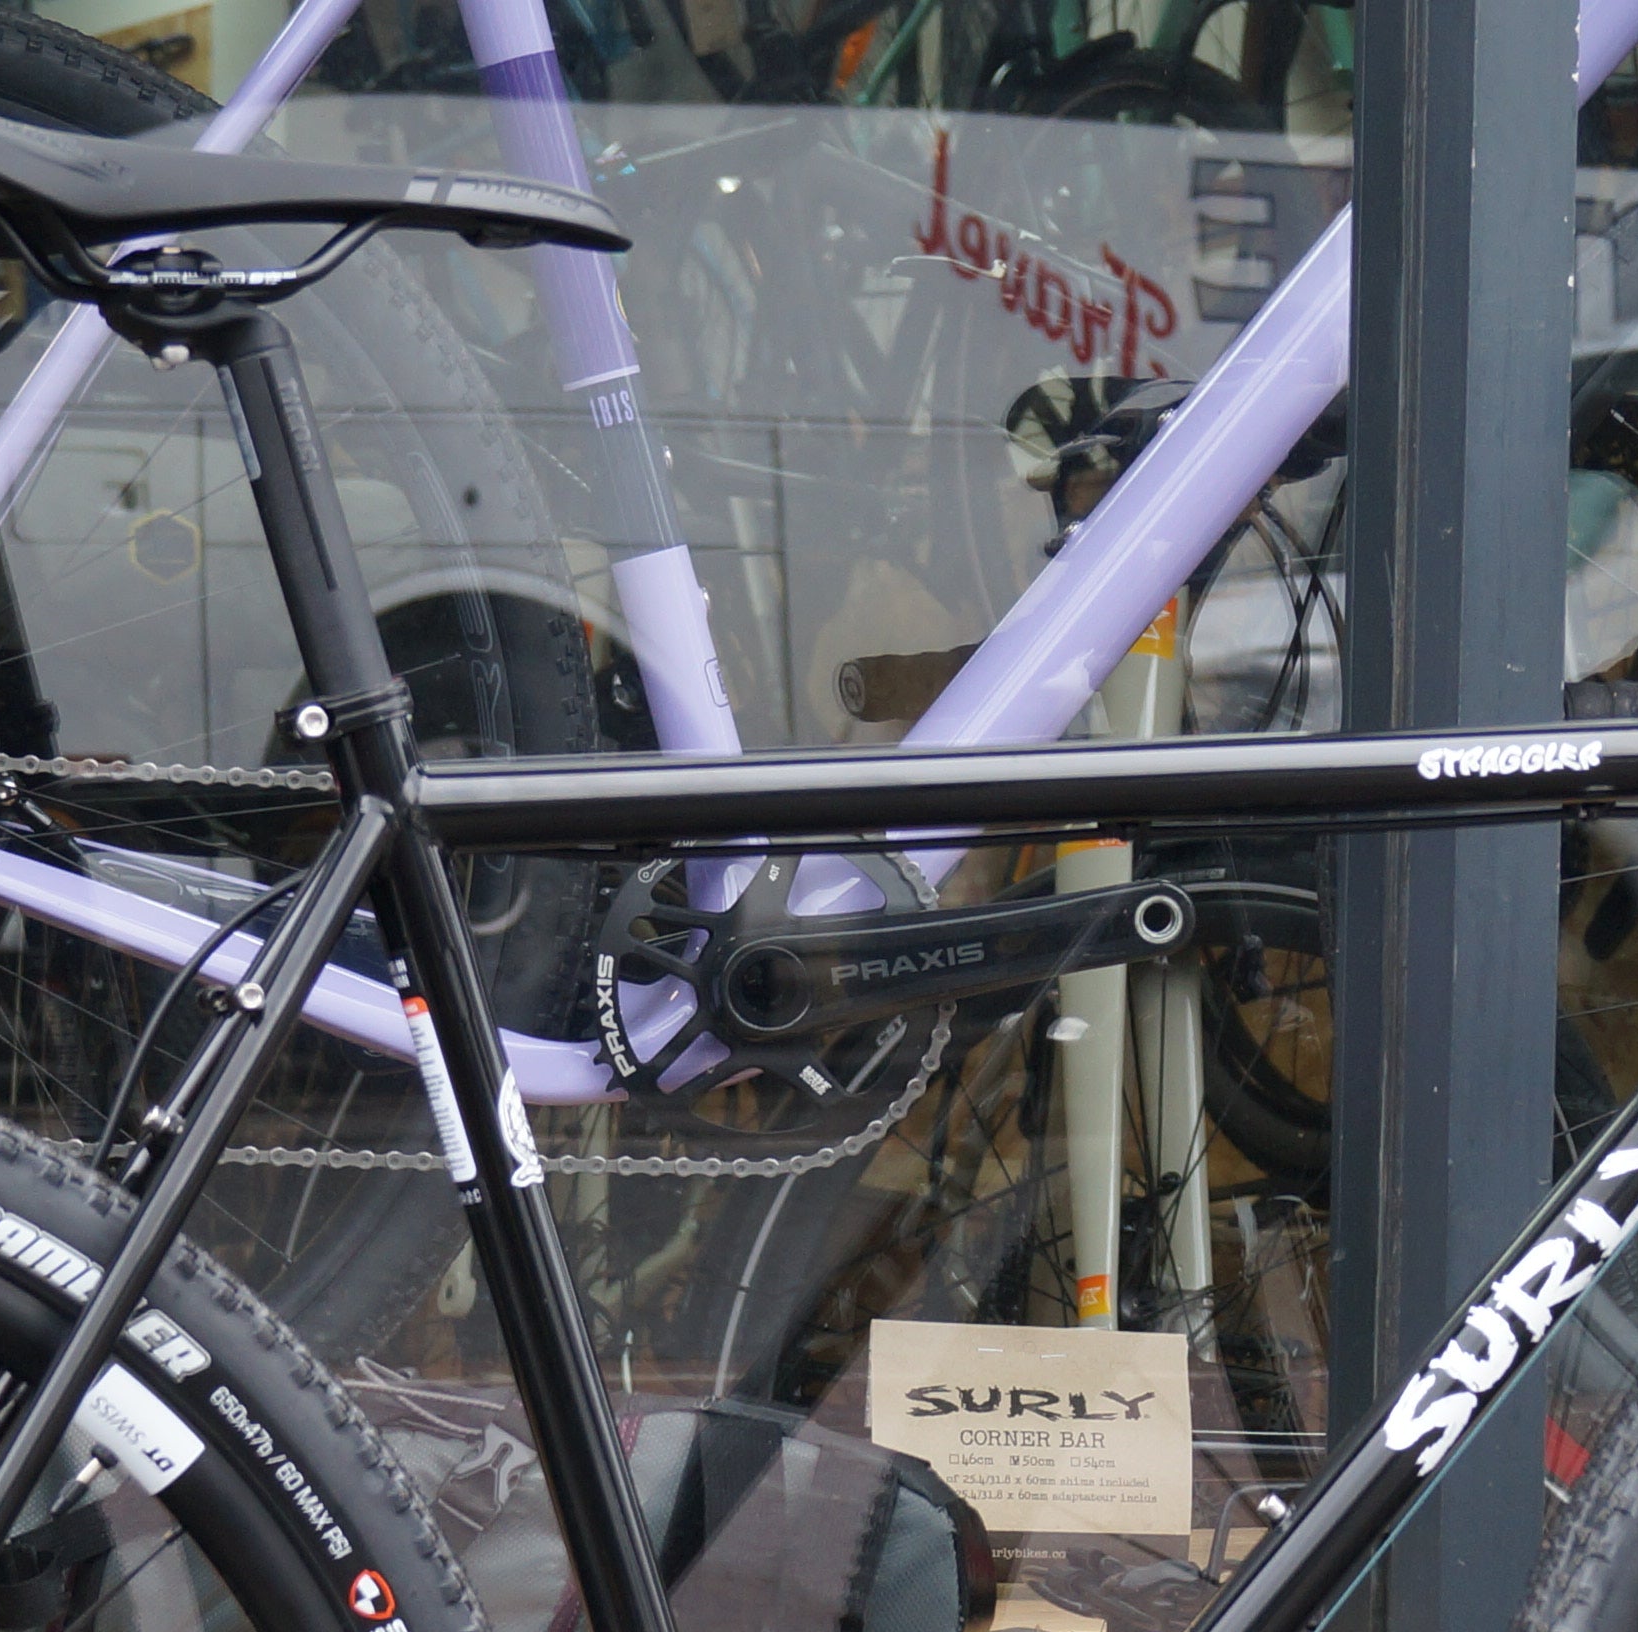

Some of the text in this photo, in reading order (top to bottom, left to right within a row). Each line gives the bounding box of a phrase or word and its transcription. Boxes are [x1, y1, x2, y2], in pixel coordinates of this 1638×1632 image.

[589, 397, 637, 431] IBIS
[1417, 740, 1603, 780] STRAGGLER
[830, 941, 985, 987] PRAXIS
[596, 954, 638, 1078] PRAXIS
[905, 1384, 1156, 1421] SURLY
[85, 1396, 174, 1473] DT SWISS
[960, 1430, 1105, 1449] CORNER BAR
[292, 1485, 335, 1532] MAX
